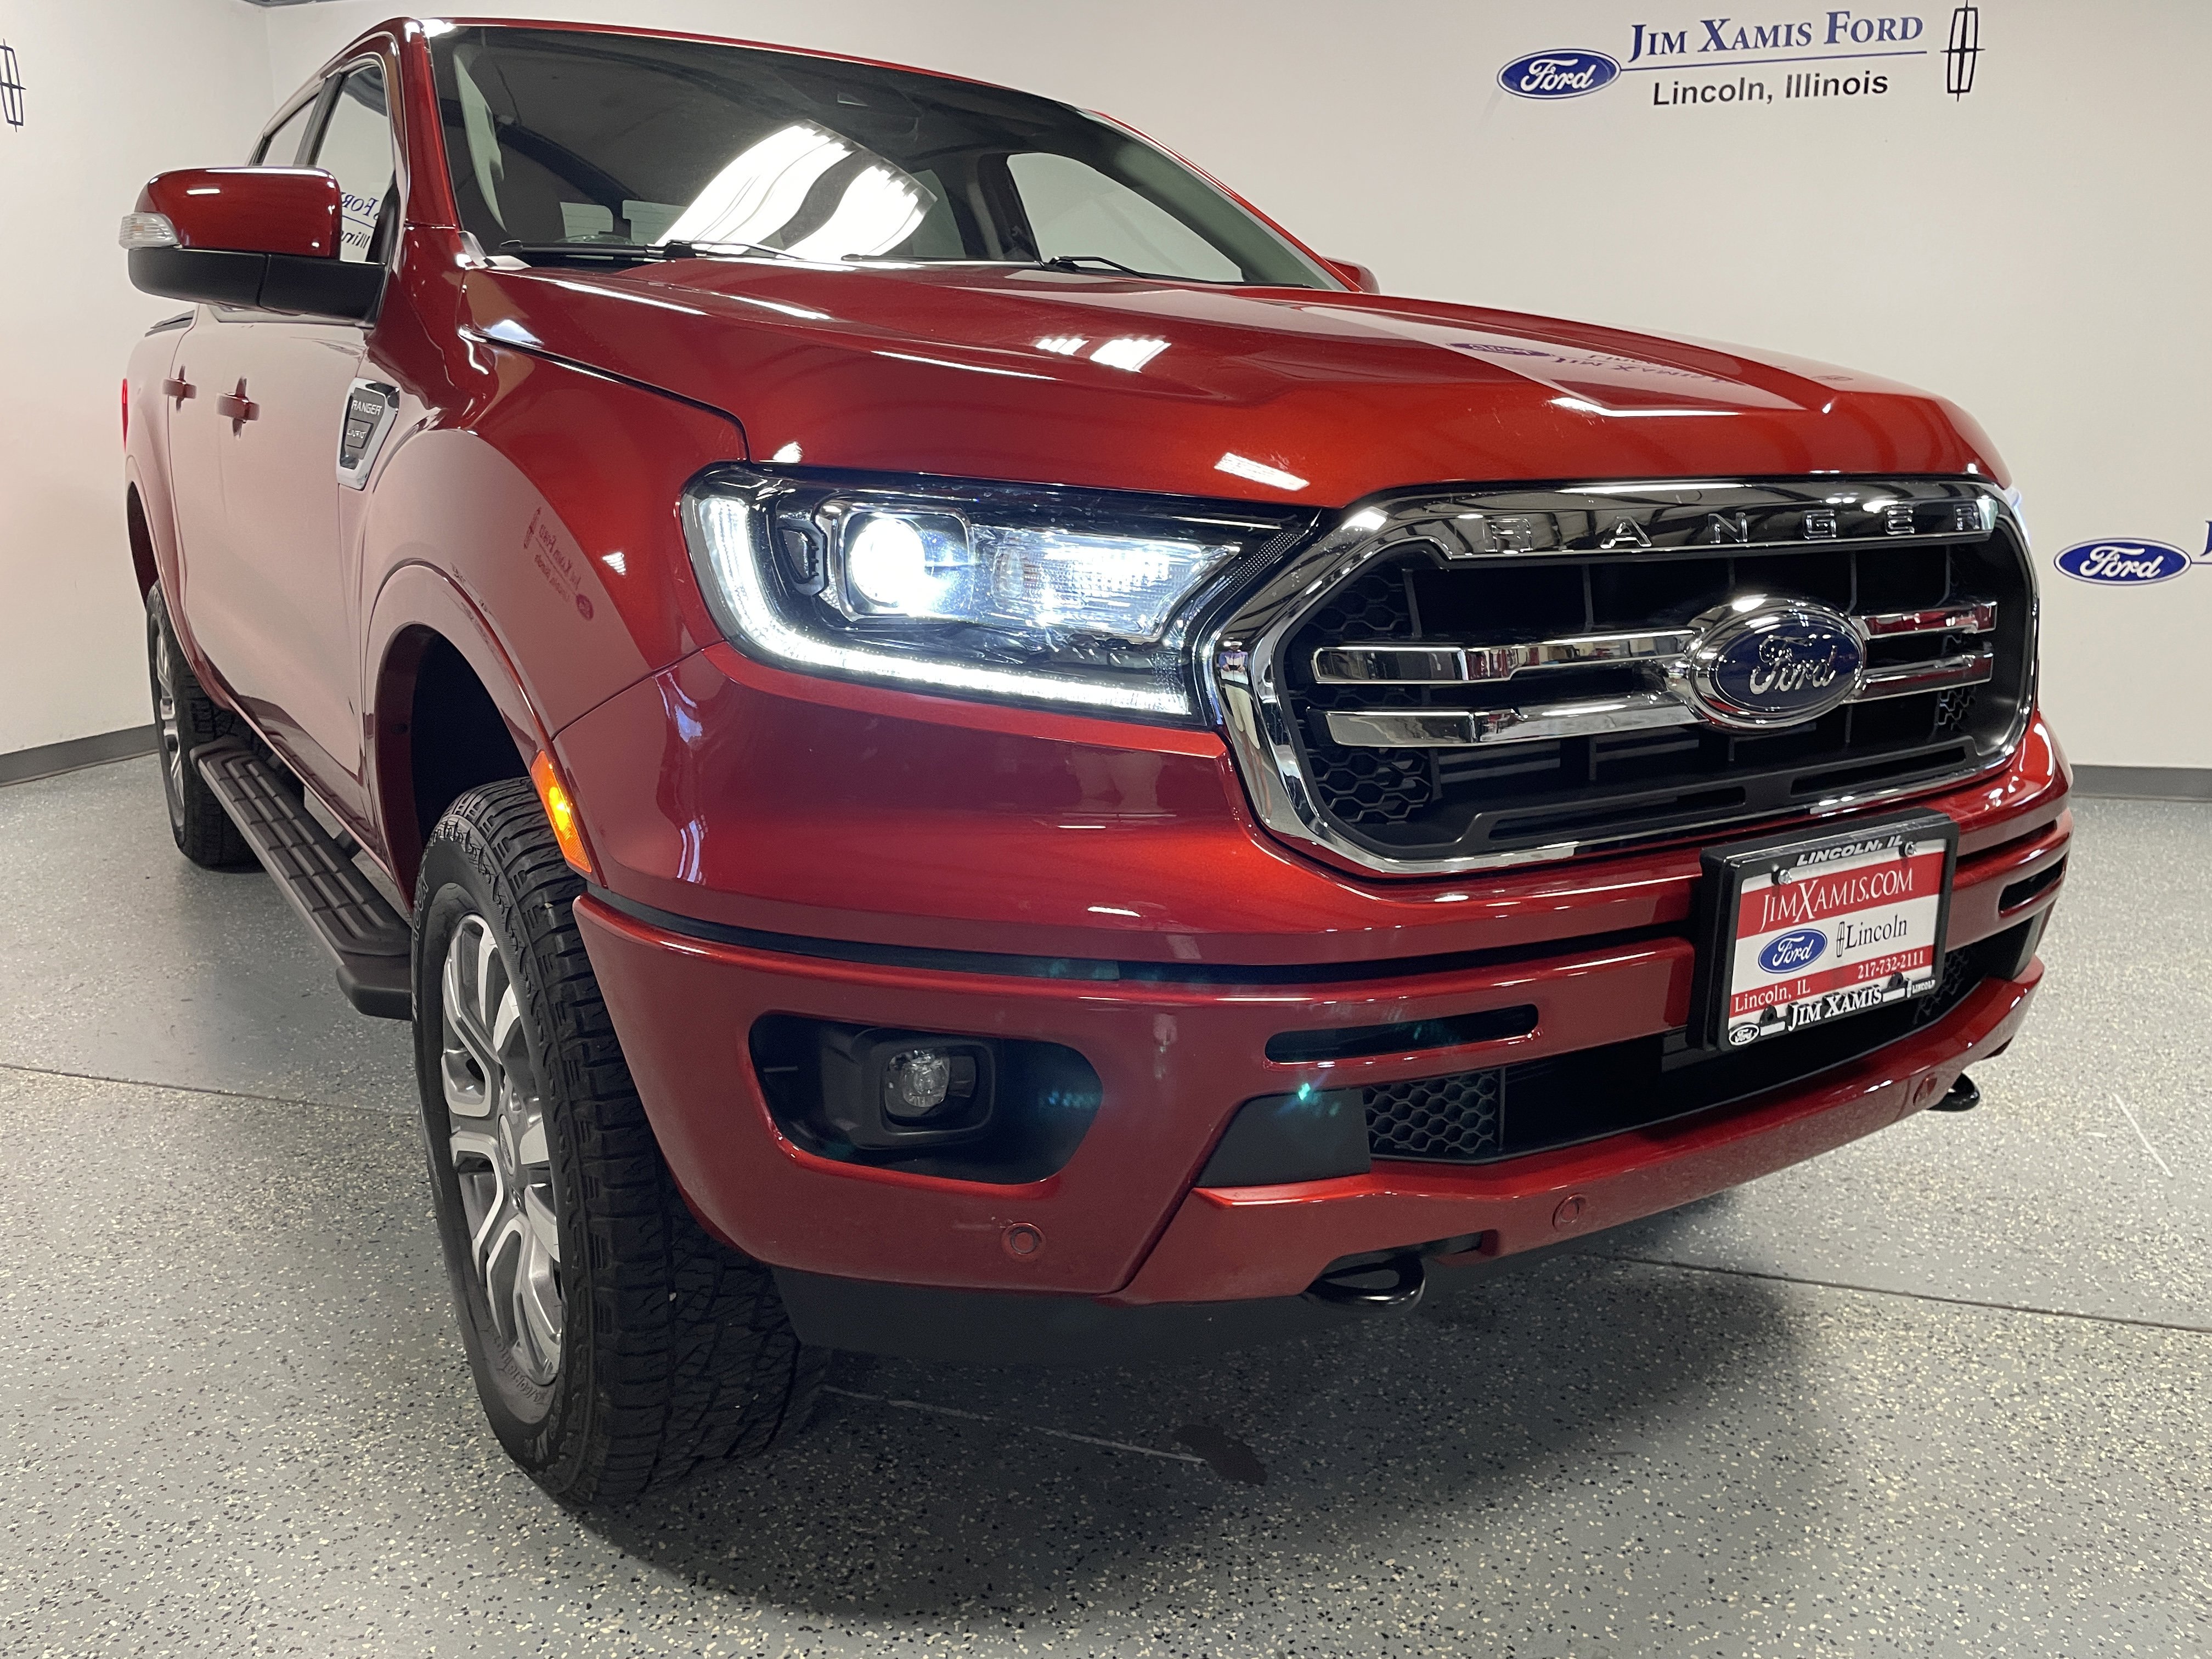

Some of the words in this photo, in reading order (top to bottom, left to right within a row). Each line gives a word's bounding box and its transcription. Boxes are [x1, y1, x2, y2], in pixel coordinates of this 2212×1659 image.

[1628, 24, 1688, 63] JIM
[1697, 19, 1812, 52] XAMIS
[1824, 11, 1923, 44] FORD
[1520, 58, 1596, 92] Ford
[1653, 77, 1773, 105] Lincoln,
[1786, 70, 1888, 98] Illinois
[351, 399, 382, 416] RANGER
[1483, 503, 1980, 552] RANGER
[2079, 545, 2164, 578] Ford
[1750, 634, 1836, 695] Ford
[1797, 840, 1883, 866] LINCOLN,
[1887, 835, 1903, 848] IL
[1759, 868, 1914, 933] JIMXAMIS.COM
[1844, 913, 1907, 950] Lincoln
[1771, 935, 1813, 967] Ford
[1858, 950, 1923, 980] 217-732-2111
[1735, 985, 1791, 1013] Lincoln,
[1797, 979, 1810, 995] IL
[1787, 1002, 1822, 1031] JIM
[1825, 986, 1882, 1019] XAMIS
